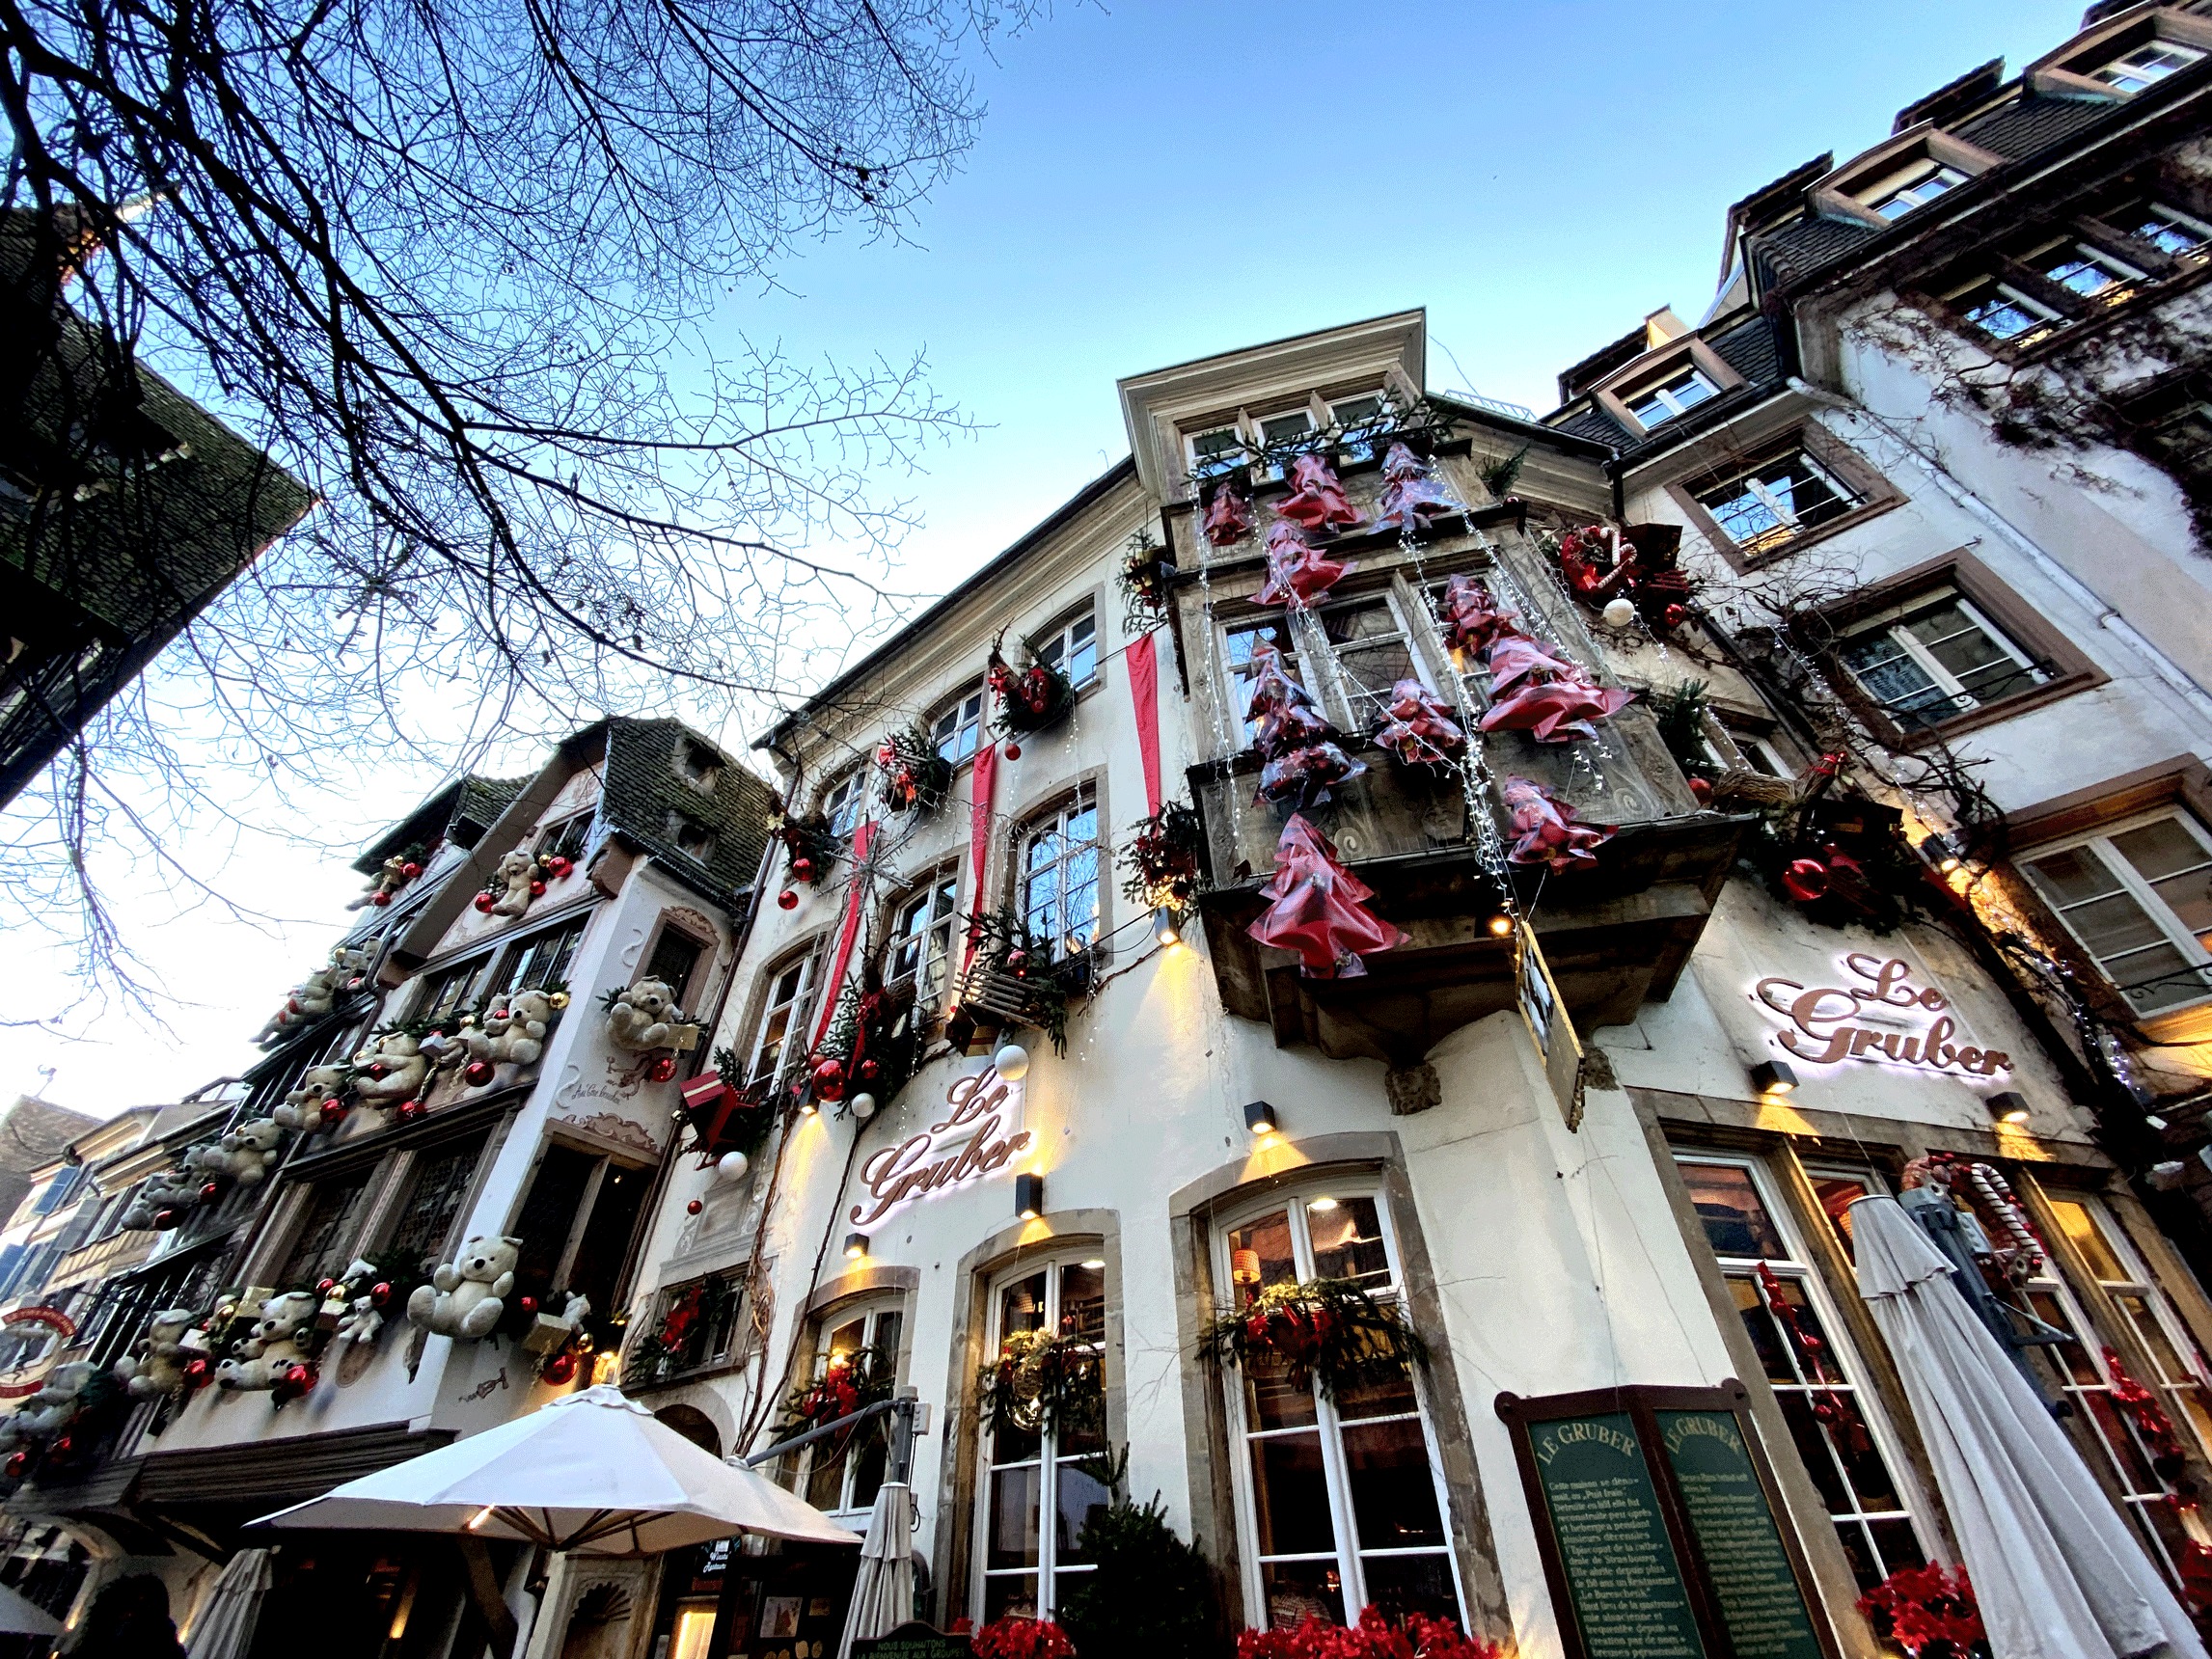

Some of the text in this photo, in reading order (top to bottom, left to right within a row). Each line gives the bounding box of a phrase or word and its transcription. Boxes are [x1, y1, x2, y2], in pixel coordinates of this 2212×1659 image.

[1846, 953, 1951, 1011] Le
[1756, 977, 2014, 1075] Gruber
[930, 1064, 1009, 1134] Le
[850, 1114, 1031, 1226] Gruber
[1537, 1423, 1635, 1465] LE GRUBER
[1664, 1417, 1742, 1456] LE GRUBER
[876, 1640, 898, 1650] NOUS
